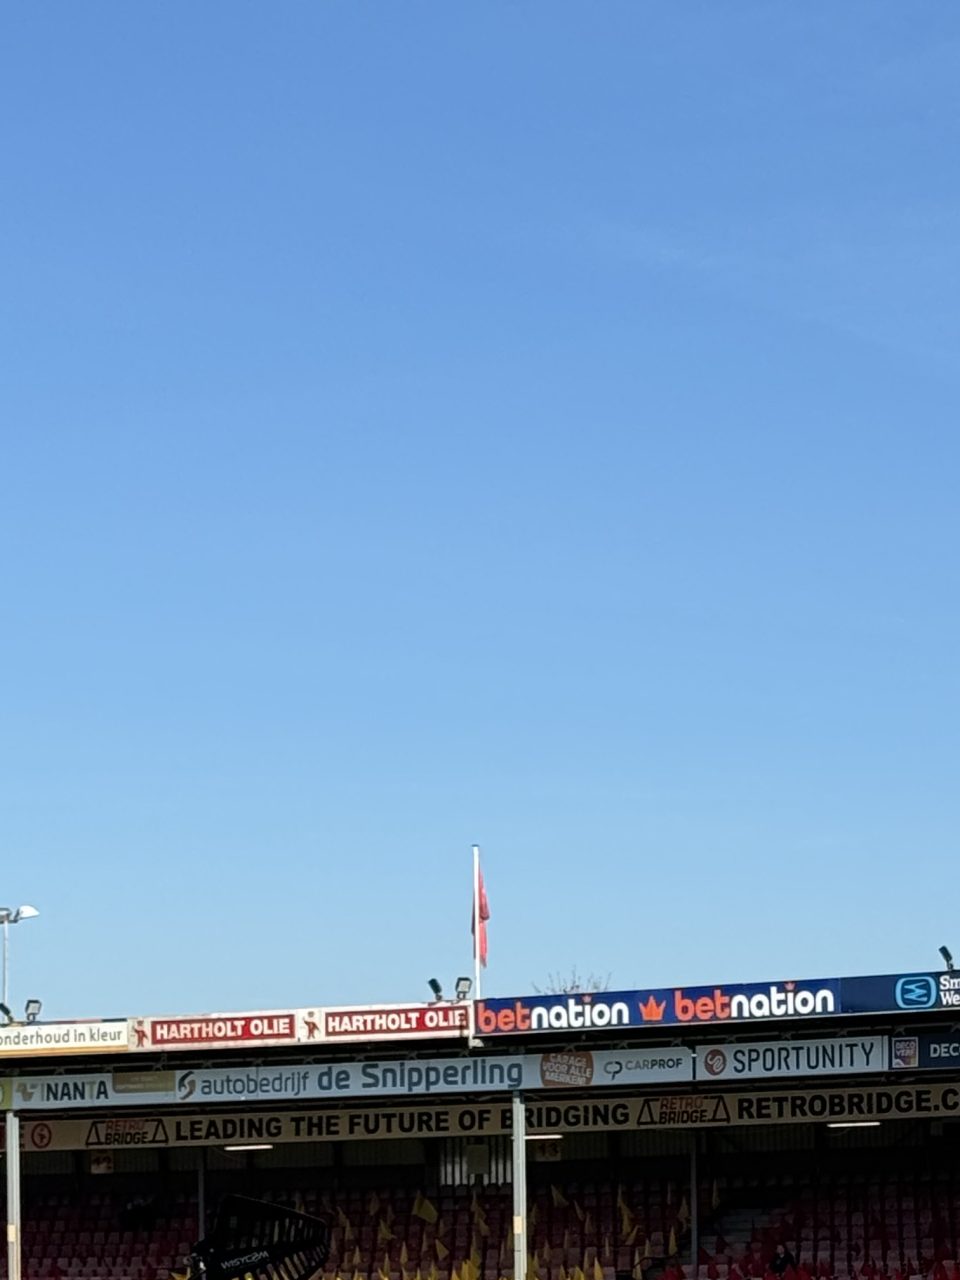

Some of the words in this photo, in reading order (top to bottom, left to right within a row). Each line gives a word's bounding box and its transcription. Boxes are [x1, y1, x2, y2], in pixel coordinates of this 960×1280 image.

[674, 982, 835, 1021] betnation
[327, 1011, 420, 1033] HARTHOLT
[424, 1008, 467, 1027] OLIE
[478, 996, 629, 1033] betnation
[74, 1029, 86, 1043] in
[89, 1026, 122, 1042] kleur
[155, 1019, 246, 1041] HARTHOLT
[250, 1017, 291, 1036] OLIE
[625, 1057, 683, 1072] CARPROF
[733, 1041, 874, 1074] SPORTUNITY
[201, 1071, 309, 1096] autobedrijf
[317, 1065, 350, 1091] de
[361, 1058, 523, 1093] Snipperling
[175, 1116, 283, 1141] LEADING
[290, 1114, 340, 1137] THE
[348, 1111, 450, 1135] FUTURE
[458, 1109, 491, 1131] OF
[658, 1110, 708, 1125] BRIDGE
[104, 1131, 149, 1145] BRIDGE
